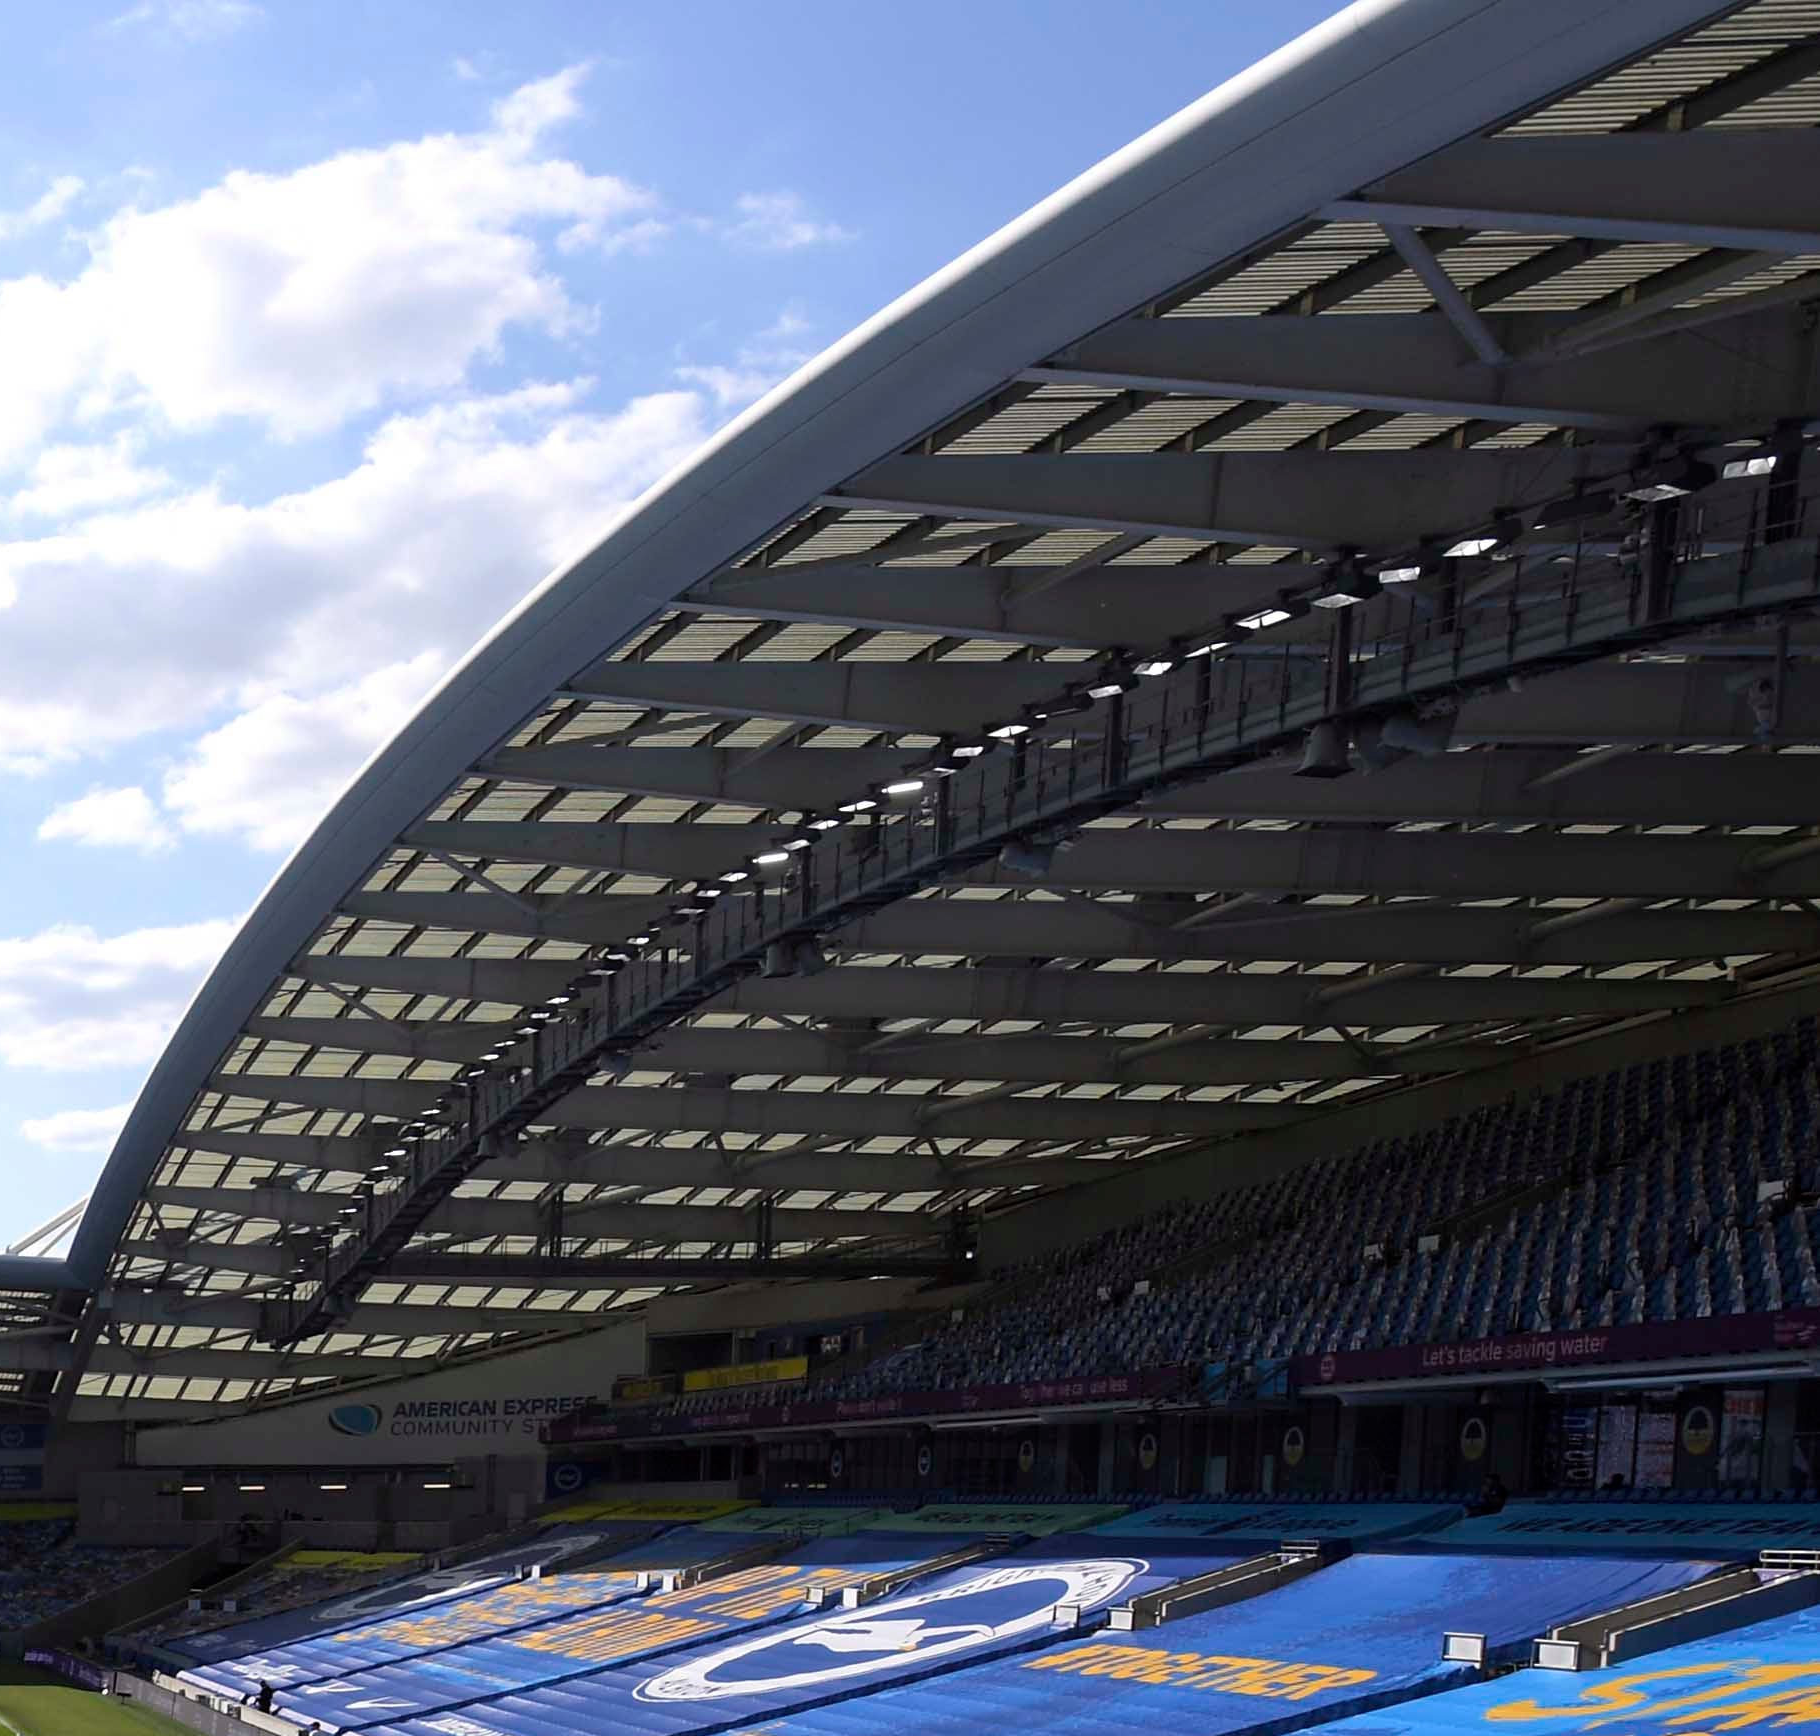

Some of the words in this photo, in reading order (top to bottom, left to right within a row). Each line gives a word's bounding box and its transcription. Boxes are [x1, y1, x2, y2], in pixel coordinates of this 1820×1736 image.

[1422, 1344, 1456, 1368] Let's
[1458, 1341, 1503, 1364] tackle
[1505, 1337, 1558, 1363] saving
[1561, 1333, 1609, 1357] water
[391, 1399, 497, 1419] AMERICAN
[390, 1417, 512, 1436] COMMUNITY
[1019, 1644, 1377, 1701] #TOGETHER
